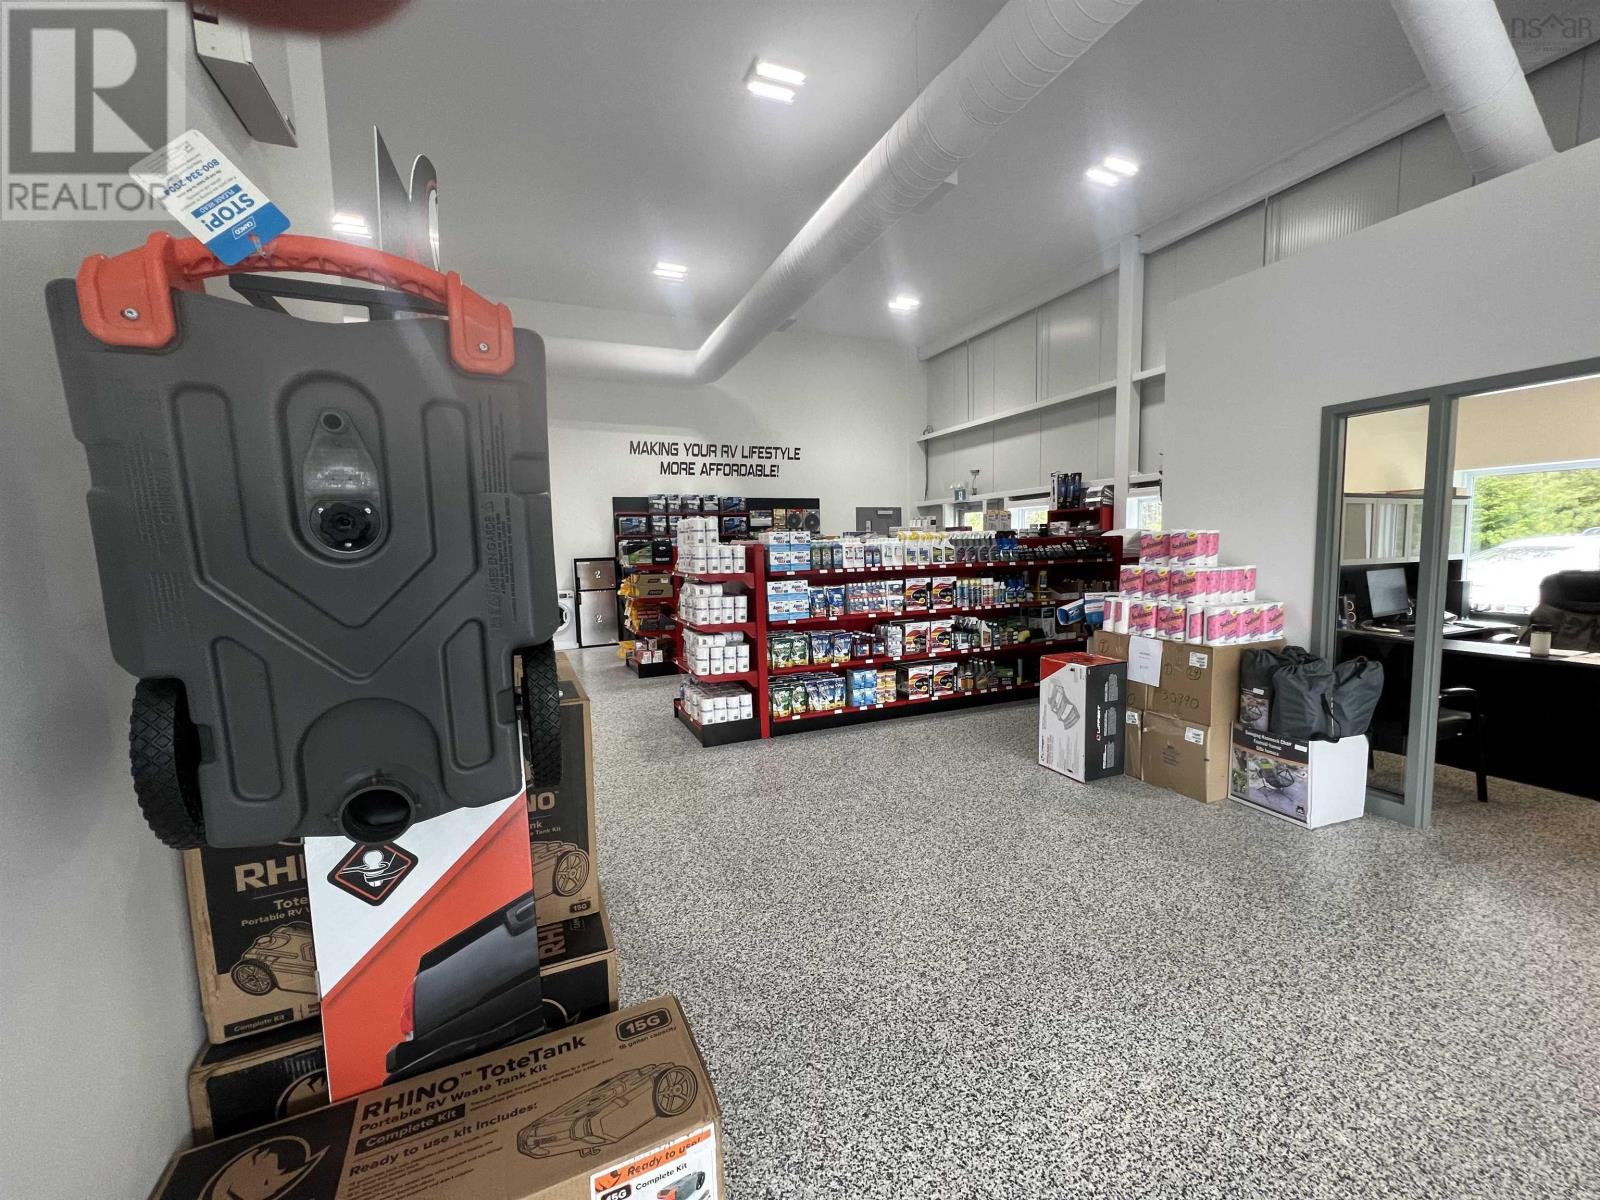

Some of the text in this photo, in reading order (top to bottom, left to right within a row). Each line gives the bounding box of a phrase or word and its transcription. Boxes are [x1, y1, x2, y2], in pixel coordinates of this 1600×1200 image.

[201, 193, 255, 232] STOP!
[629, 441, 801, 461] MAKING YOUR RV LIFESTYLE
[660, 461, 780, 478] MORE AFFORDABLE!
[241, 908, 304, 927] Portable RV
[233, 1014, 285, 1032] Complete Kit
[625, 1014, 661, 1035] 15G
[477, 1035, 587, 1081] ToteTank
[359, 1064, 548, 1135] Portable RV Waste Tank Kit
[349, 1102, 538, 1177] Ready to use kit includes:
[366, 1110, 458, 1148] Complete Kit
[627, 1155, 663, 1177] Ready
[665, 1149, 677, 1161] to
[635, 1163, 688, 1191] Complete Kit
